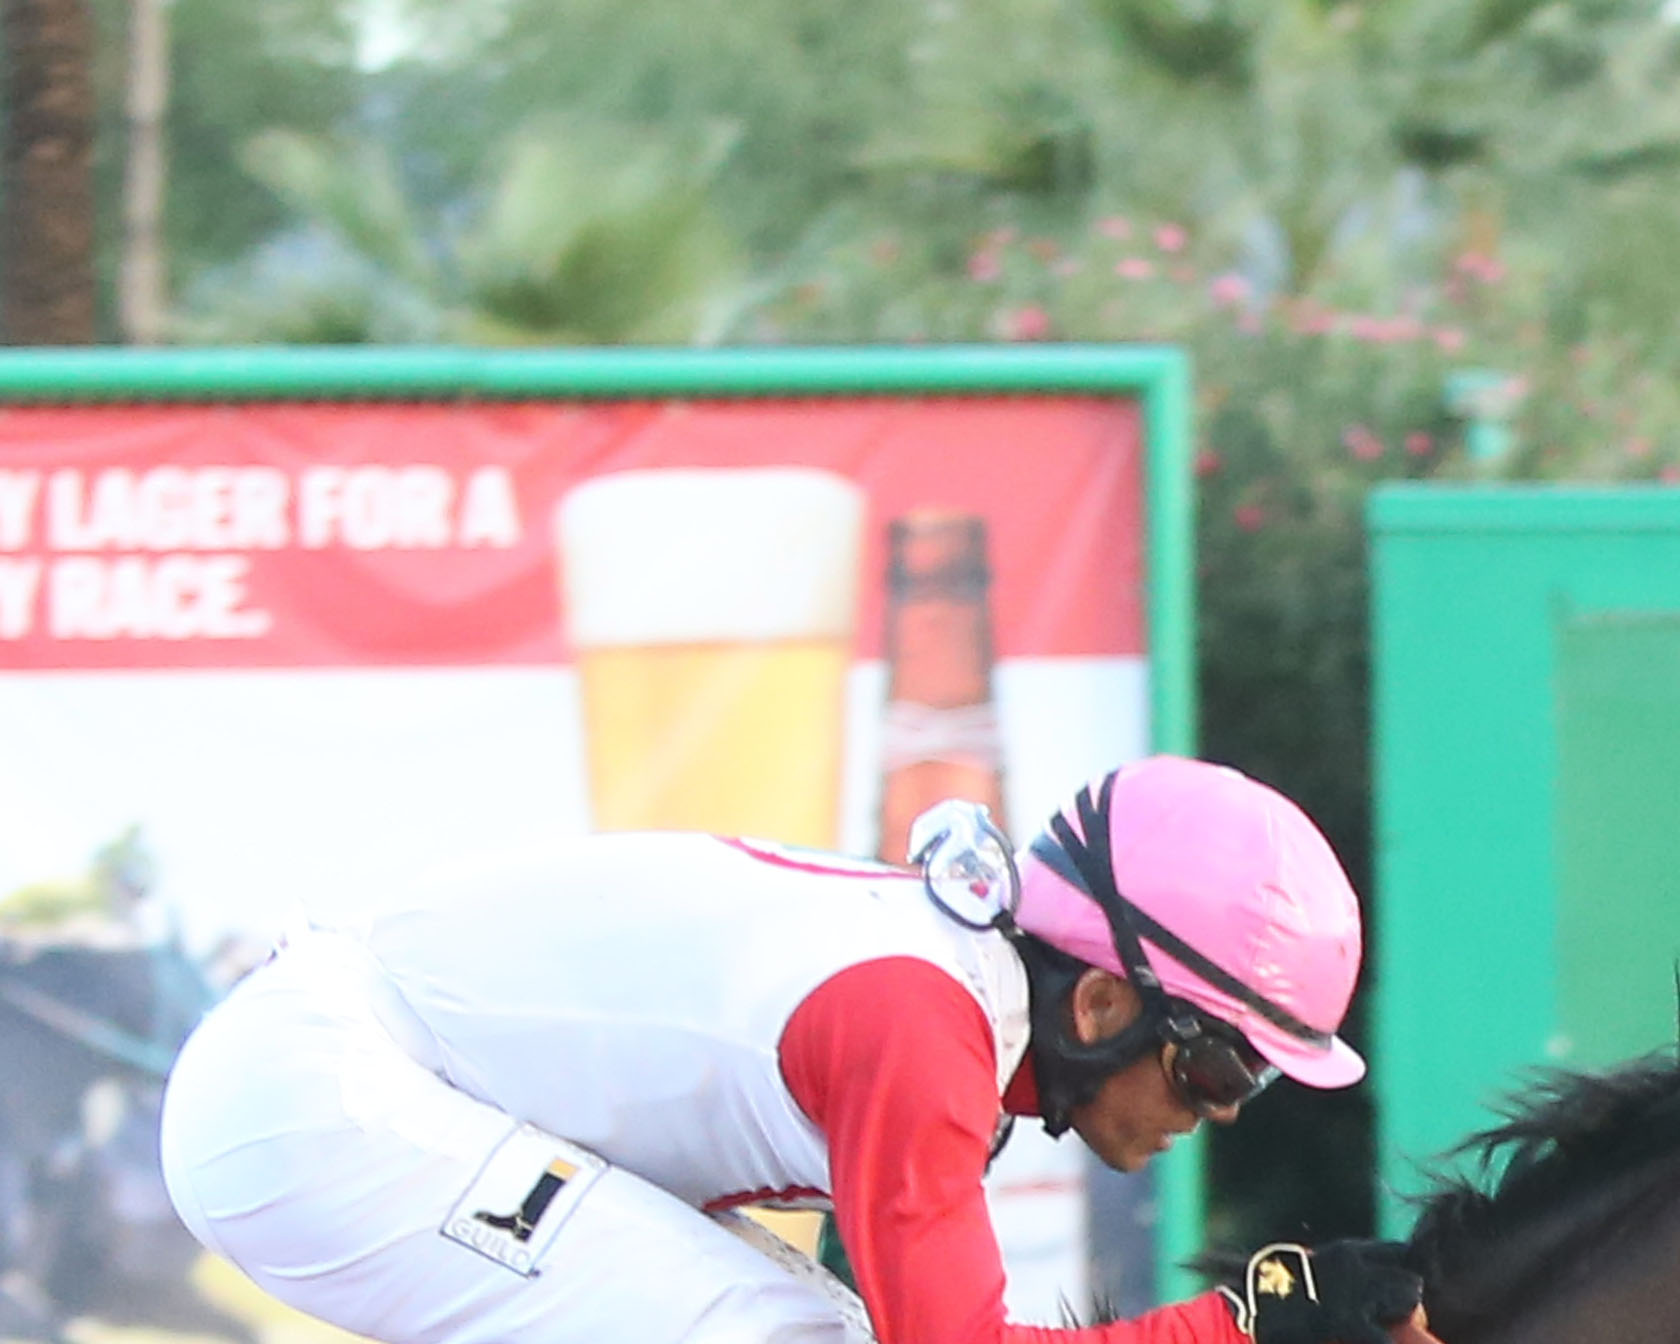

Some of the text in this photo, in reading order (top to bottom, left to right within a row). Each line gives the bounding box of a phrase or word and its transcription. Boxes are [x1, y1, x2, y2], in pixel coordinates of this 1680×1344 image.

[47, 464, 291, 552] LAGER
[299, 464, 455, 552] FOR
[457, 464, 522, 550] A
[48, 554, 271, 641] RACE.
[452, 1218, 531, 1268] GUILD
